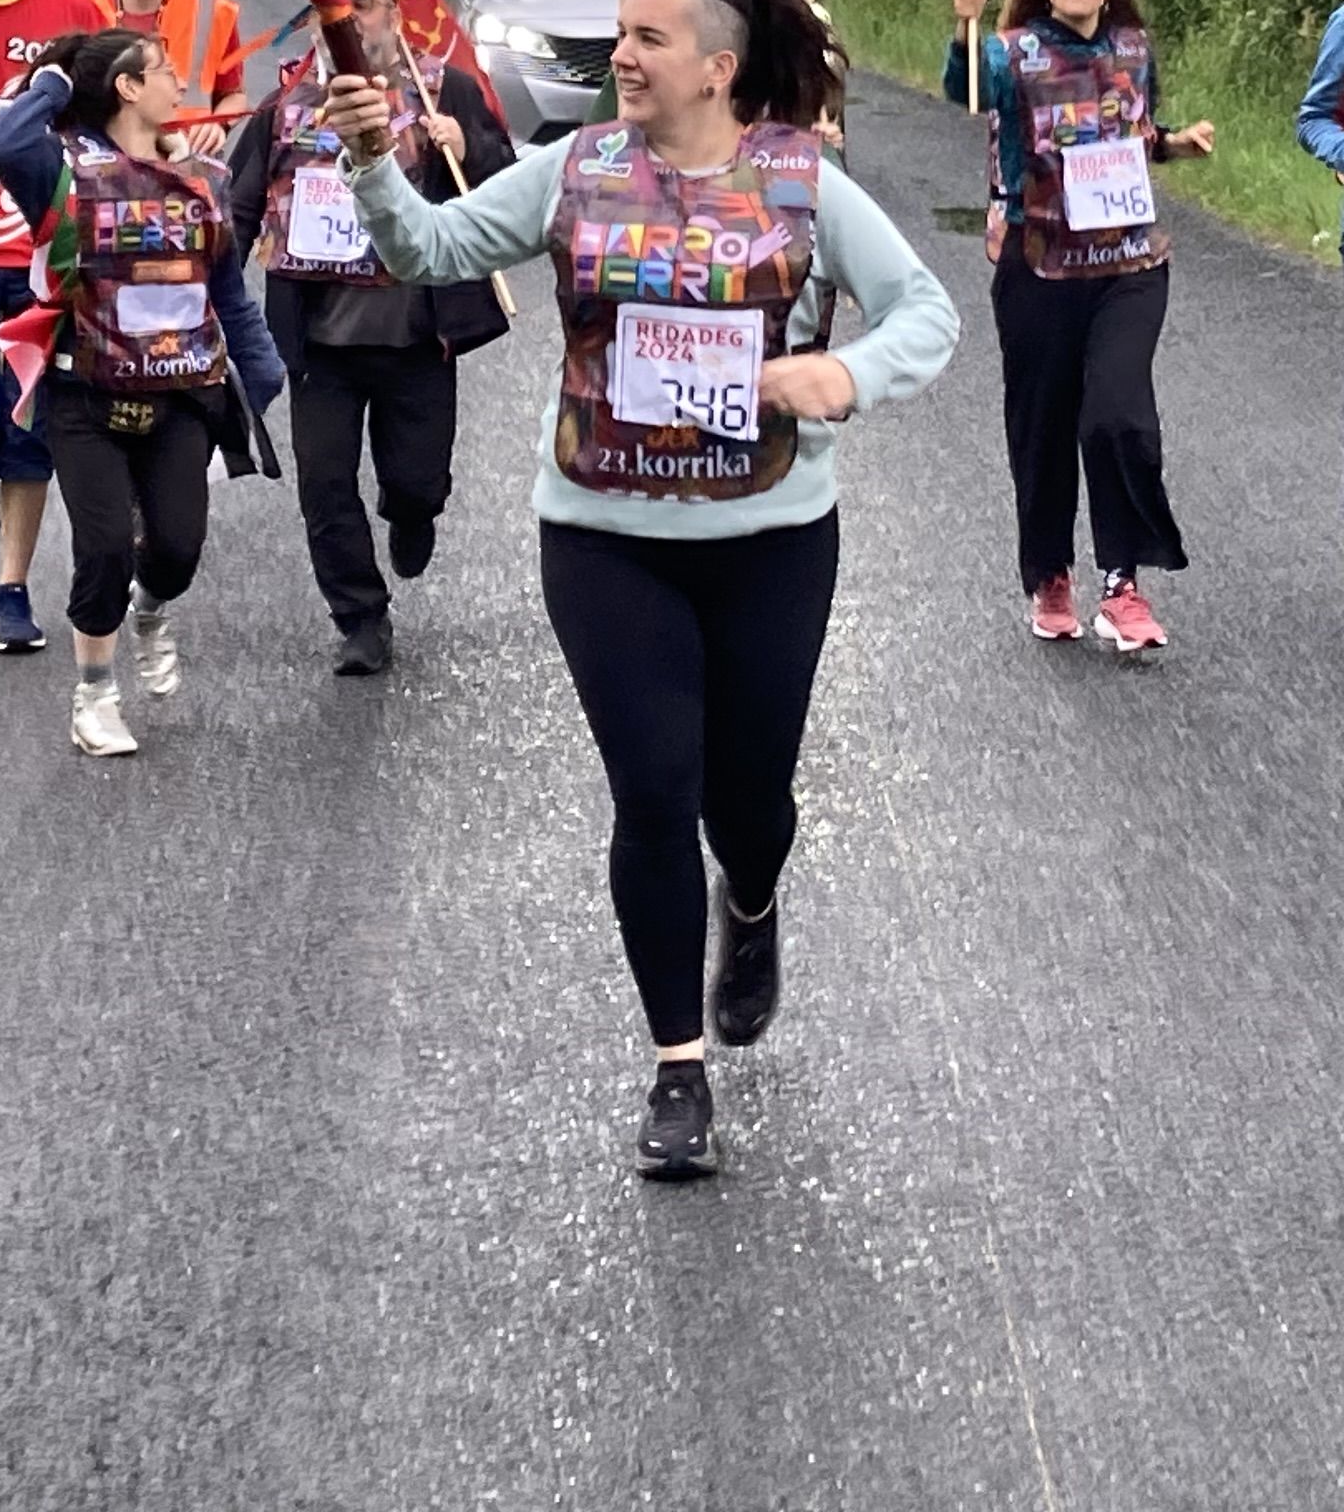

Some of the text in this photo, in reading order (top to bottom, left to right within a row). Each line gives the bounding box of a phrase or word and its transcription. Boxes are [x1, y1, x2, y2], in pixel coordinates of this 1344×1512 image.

[1093, 186, 1148, 219] 746
[635, 320, 744, 347] REDADEG
[635, 340, 694, 363] 2024
[661, 379, 747, 432] 746
